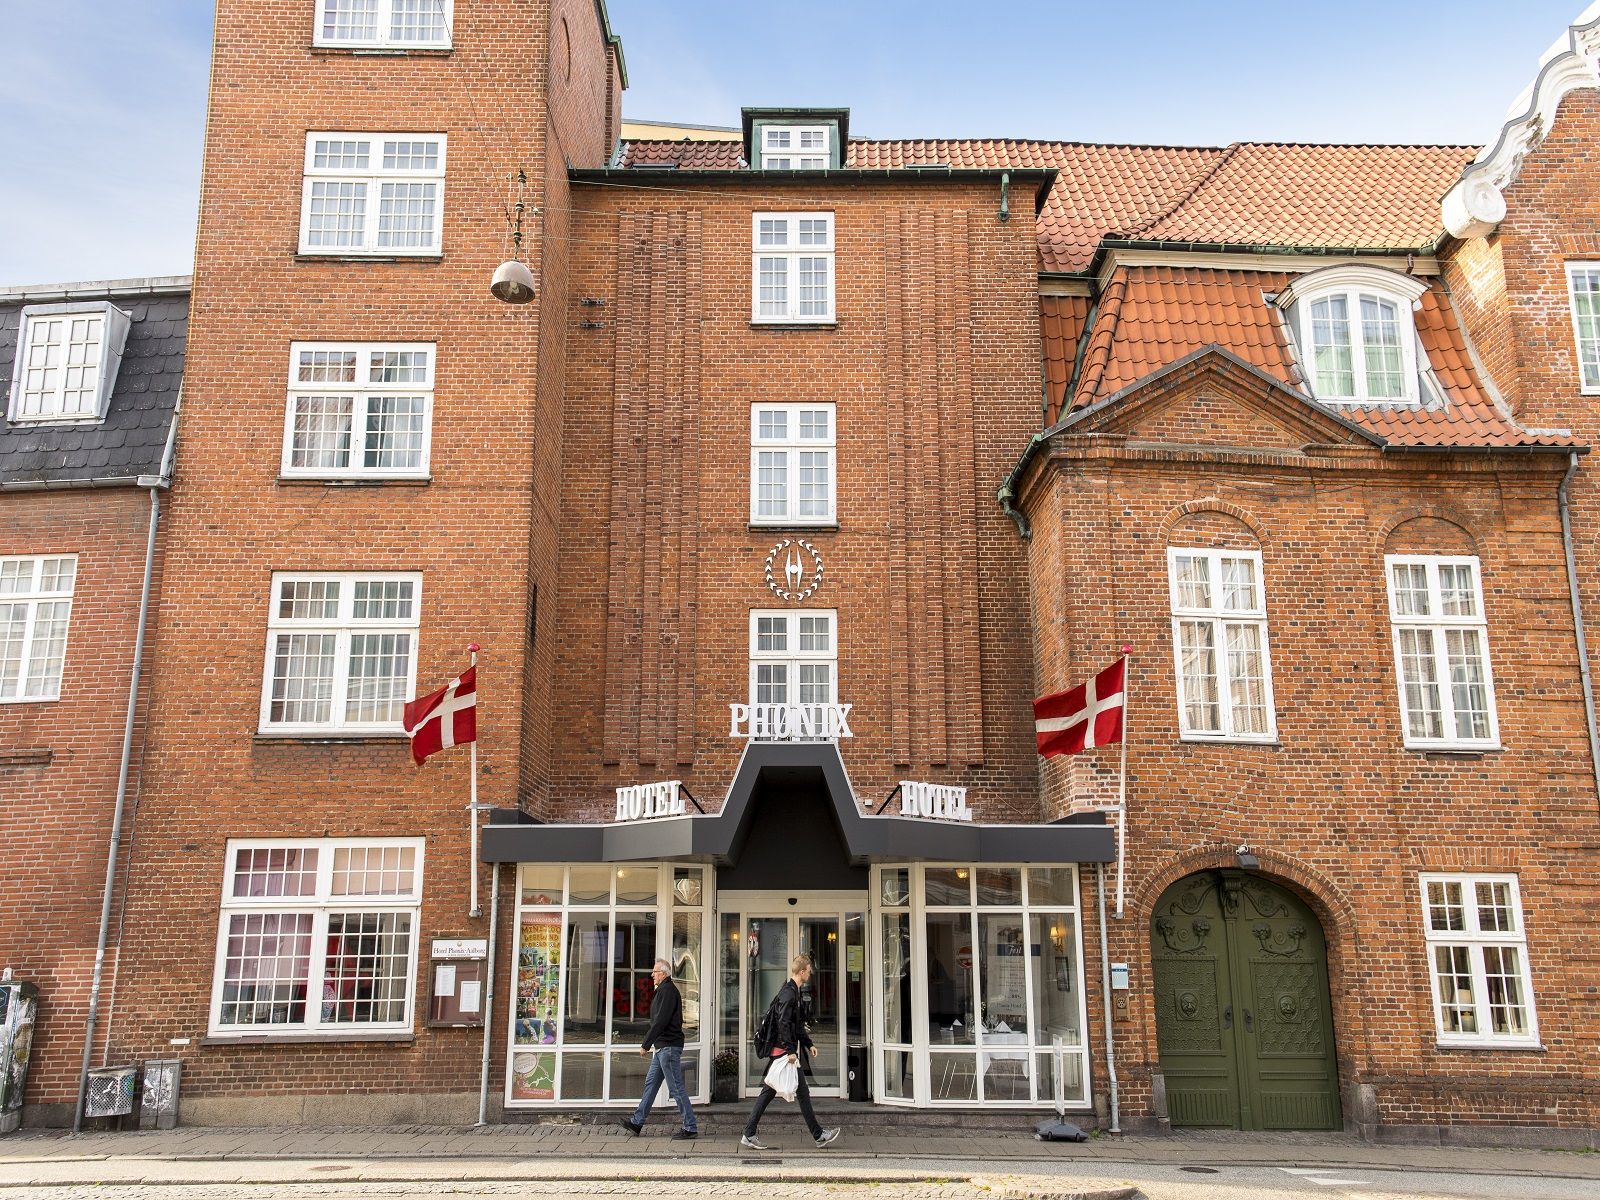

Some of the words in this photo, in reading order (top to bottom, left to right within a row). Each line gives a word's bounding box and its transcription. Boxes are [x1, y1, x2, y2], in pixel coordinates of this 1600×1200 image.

[729, 703, 853, 741] PHØNIX
[615, 780, 686, 821] HOTEL
[899, 781, 973, 821] HOTEL
